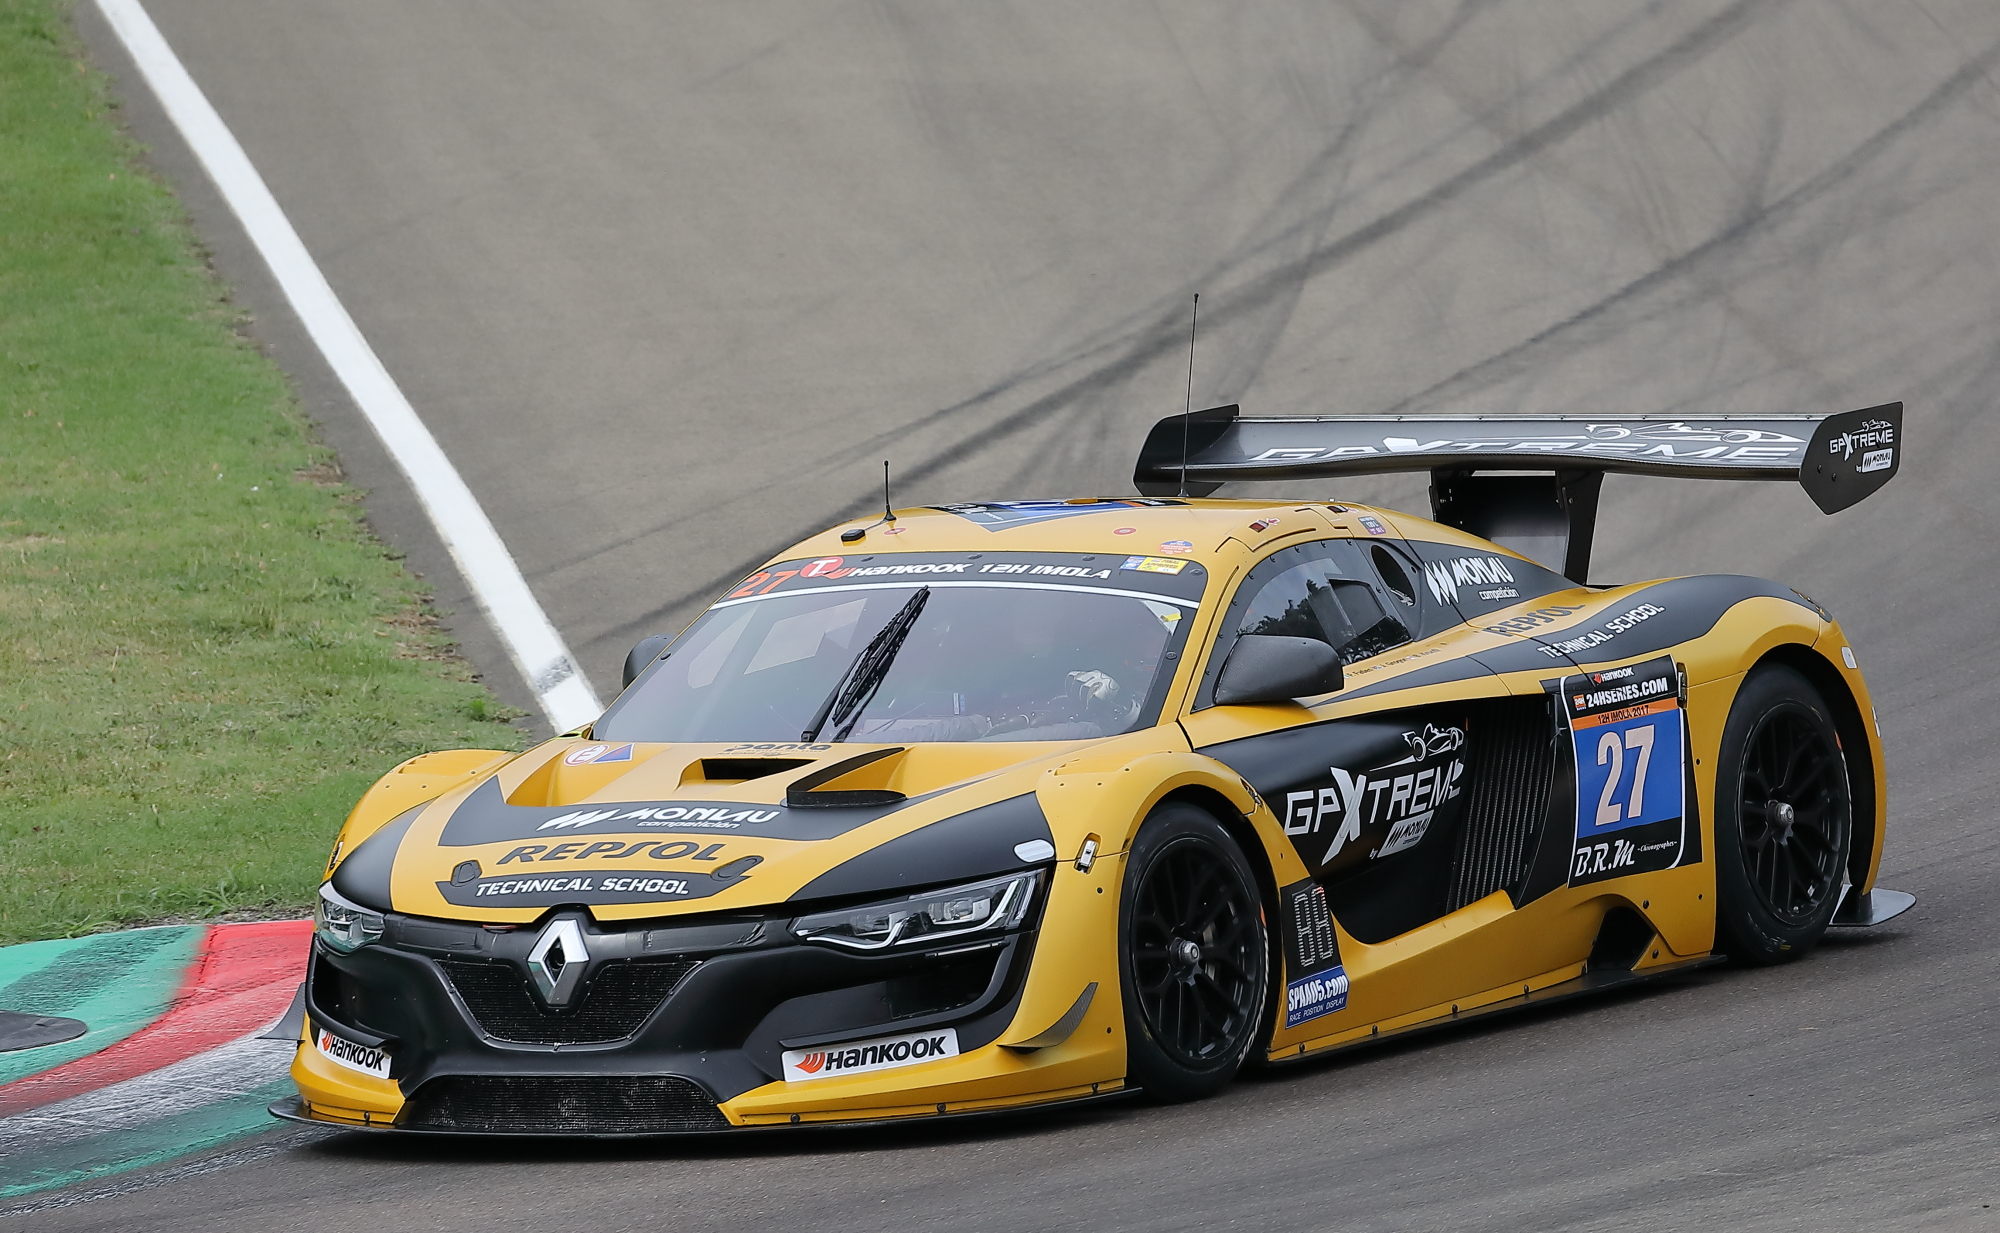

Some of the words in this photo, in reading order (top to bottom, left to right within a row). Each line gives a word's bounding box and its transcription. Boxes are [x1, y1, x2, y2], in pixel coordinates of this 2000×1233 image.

[1829, 429, 1894, 461] GPXTREME
[728, 569, 801, 599] 27
[979, 563, 1030, 575] 12H
[1029, 564, 1112, 579] IMOLA
[1482, 604, 1586, 638] REPSOL
[1537, 630, 1615, 659] TECHNICAL
[1605, 603, 1666, 634] SCHOOL
[1586, 677, 1669, 708] 24HSERIES.COM
[1597, 713, 1610, 724] 12H
[1611, 709, 1632, 721] IMOLA
[1632, 705, 1649, 718] 2017
[1595, 724, 1655, 827] 27
[496, 841, 727, 865] REPSOL
[475, 877, 594, 897] TECHNICAL
[599, 877, 690, 895] SCHOOL
[1288, 974, 1349, 1012] SPAA05.com
[1289, 1012, 1302, 1023] RACE
[1303, 1003, 1324, 1017] POSITION
[1325, 996, 1345, 1010] DISPLAY
